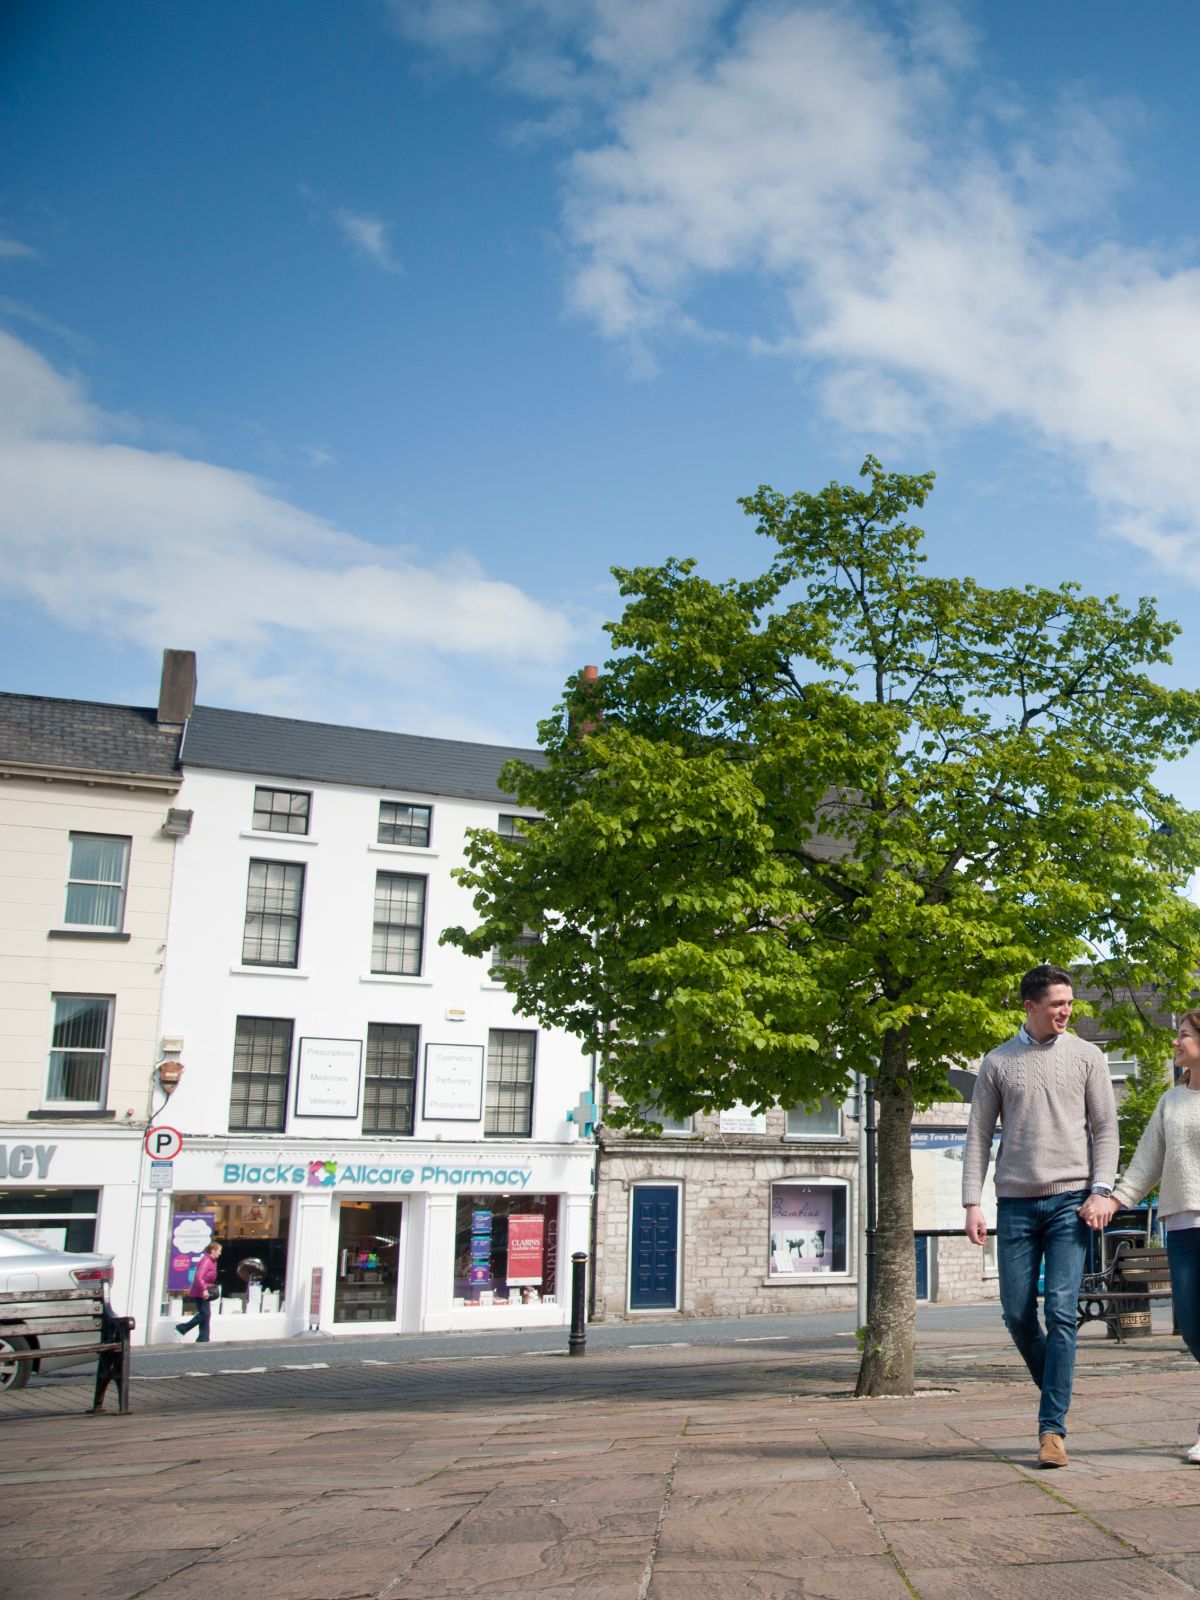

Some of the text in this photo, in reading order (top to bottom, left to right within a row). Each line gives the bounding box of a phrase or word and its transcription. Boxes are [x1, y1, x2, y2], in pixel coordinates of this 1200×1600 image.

[156, 1134, 172, 1153] P
[911, 1133, 928, 1141] ghan
[930, 1133, 949, 1141] Town
[223, 1164, 532, 1189] Black's Allcare Pharmacy
[511, 1239, 541, 1247] CLARINS
